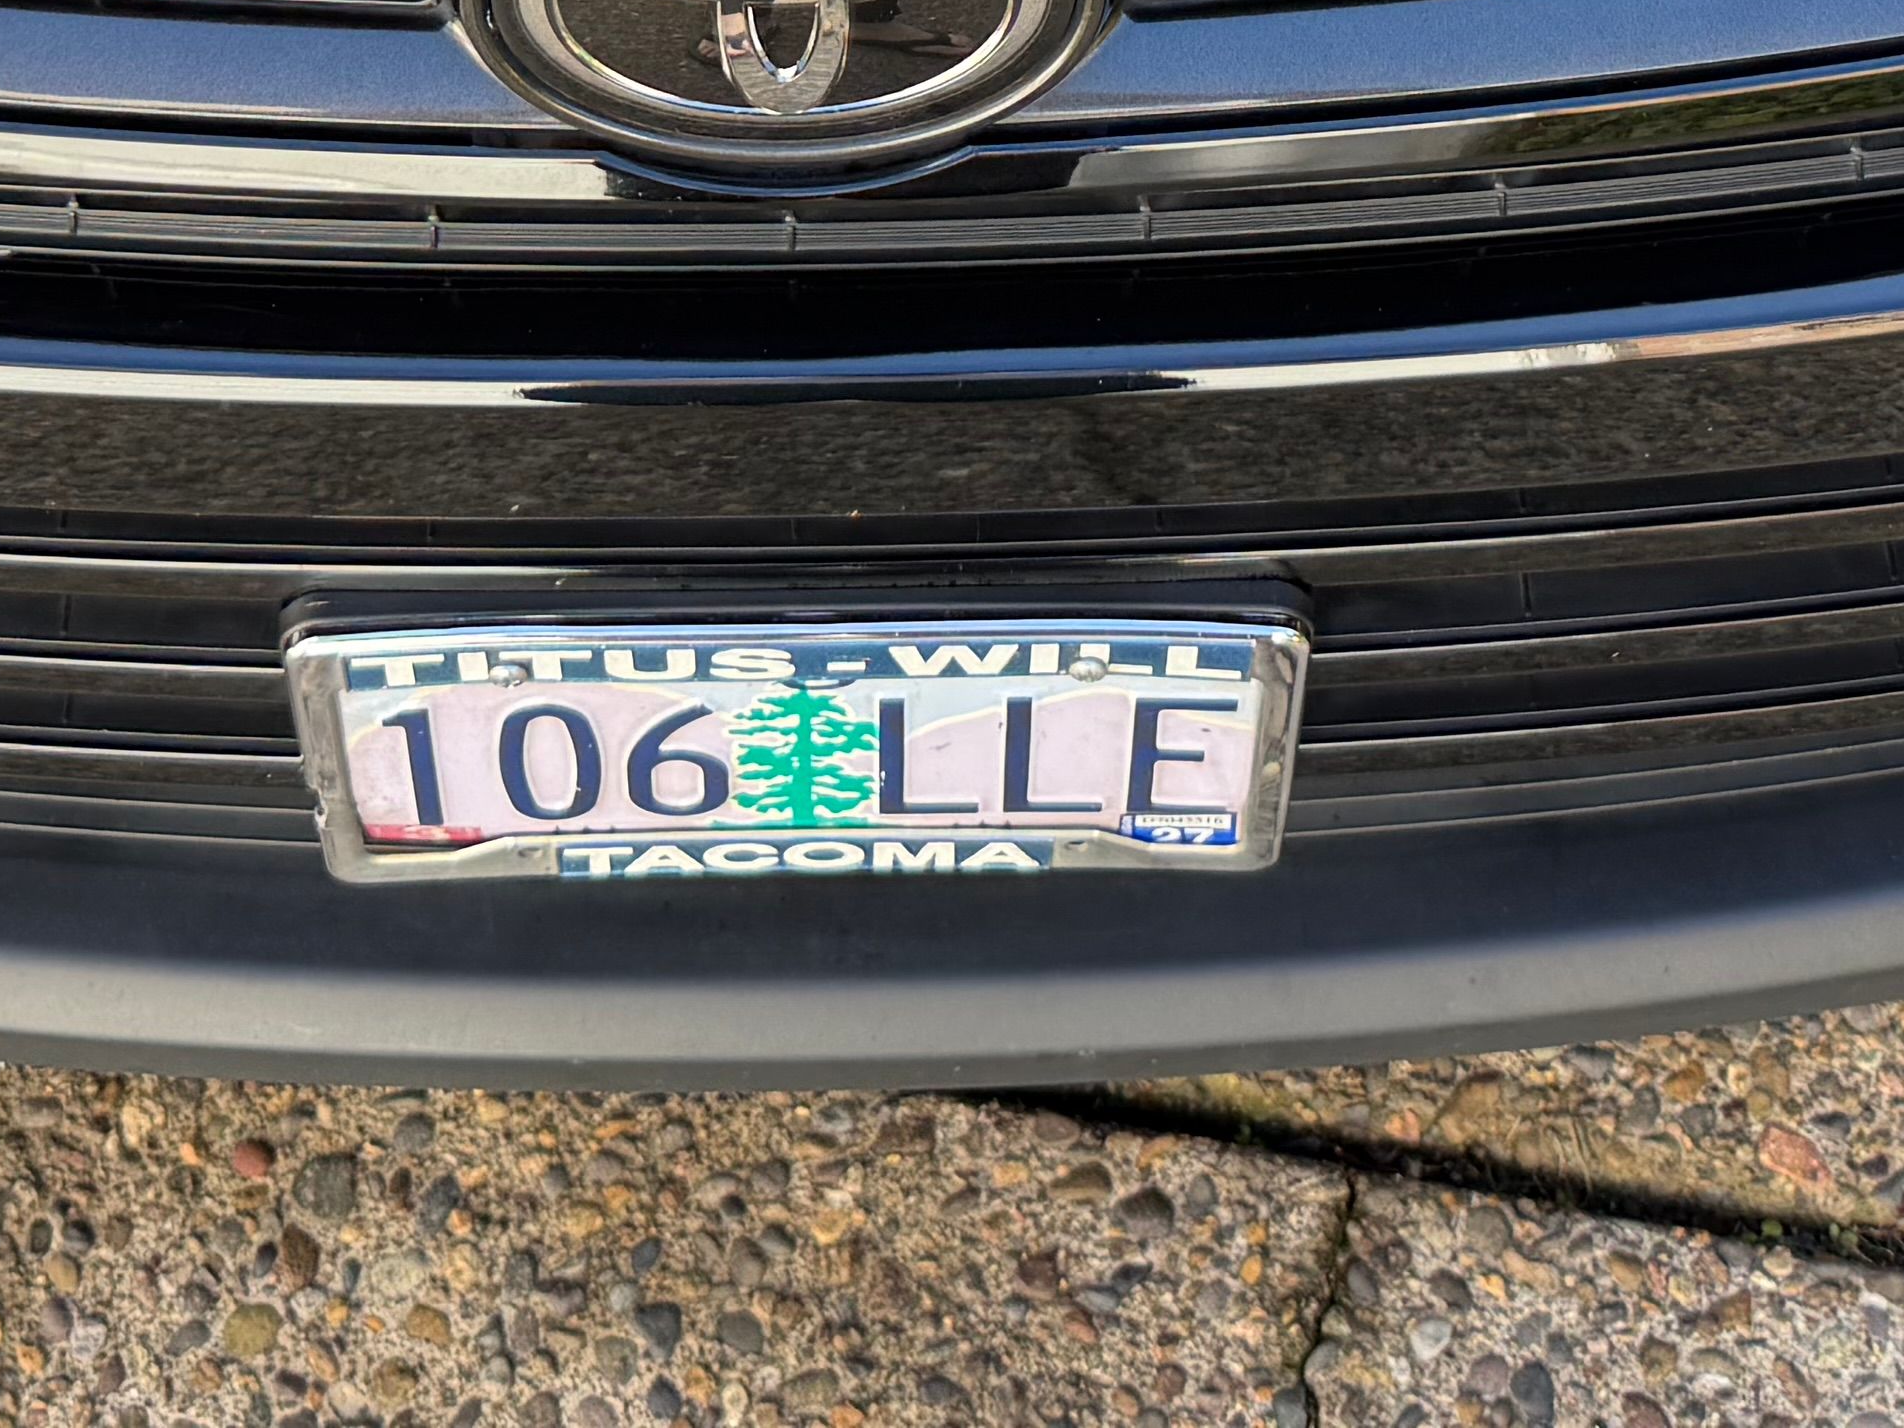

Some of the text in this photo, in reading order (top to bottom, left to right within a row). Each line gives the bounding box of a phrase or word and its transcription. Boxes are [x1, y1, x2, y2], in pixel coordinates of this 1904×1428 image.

[382, 697, 1238, 825] 106 LLE
[1151, 827, 1214, 843] 27
[562, 841, 1041, 874] TACOMA
